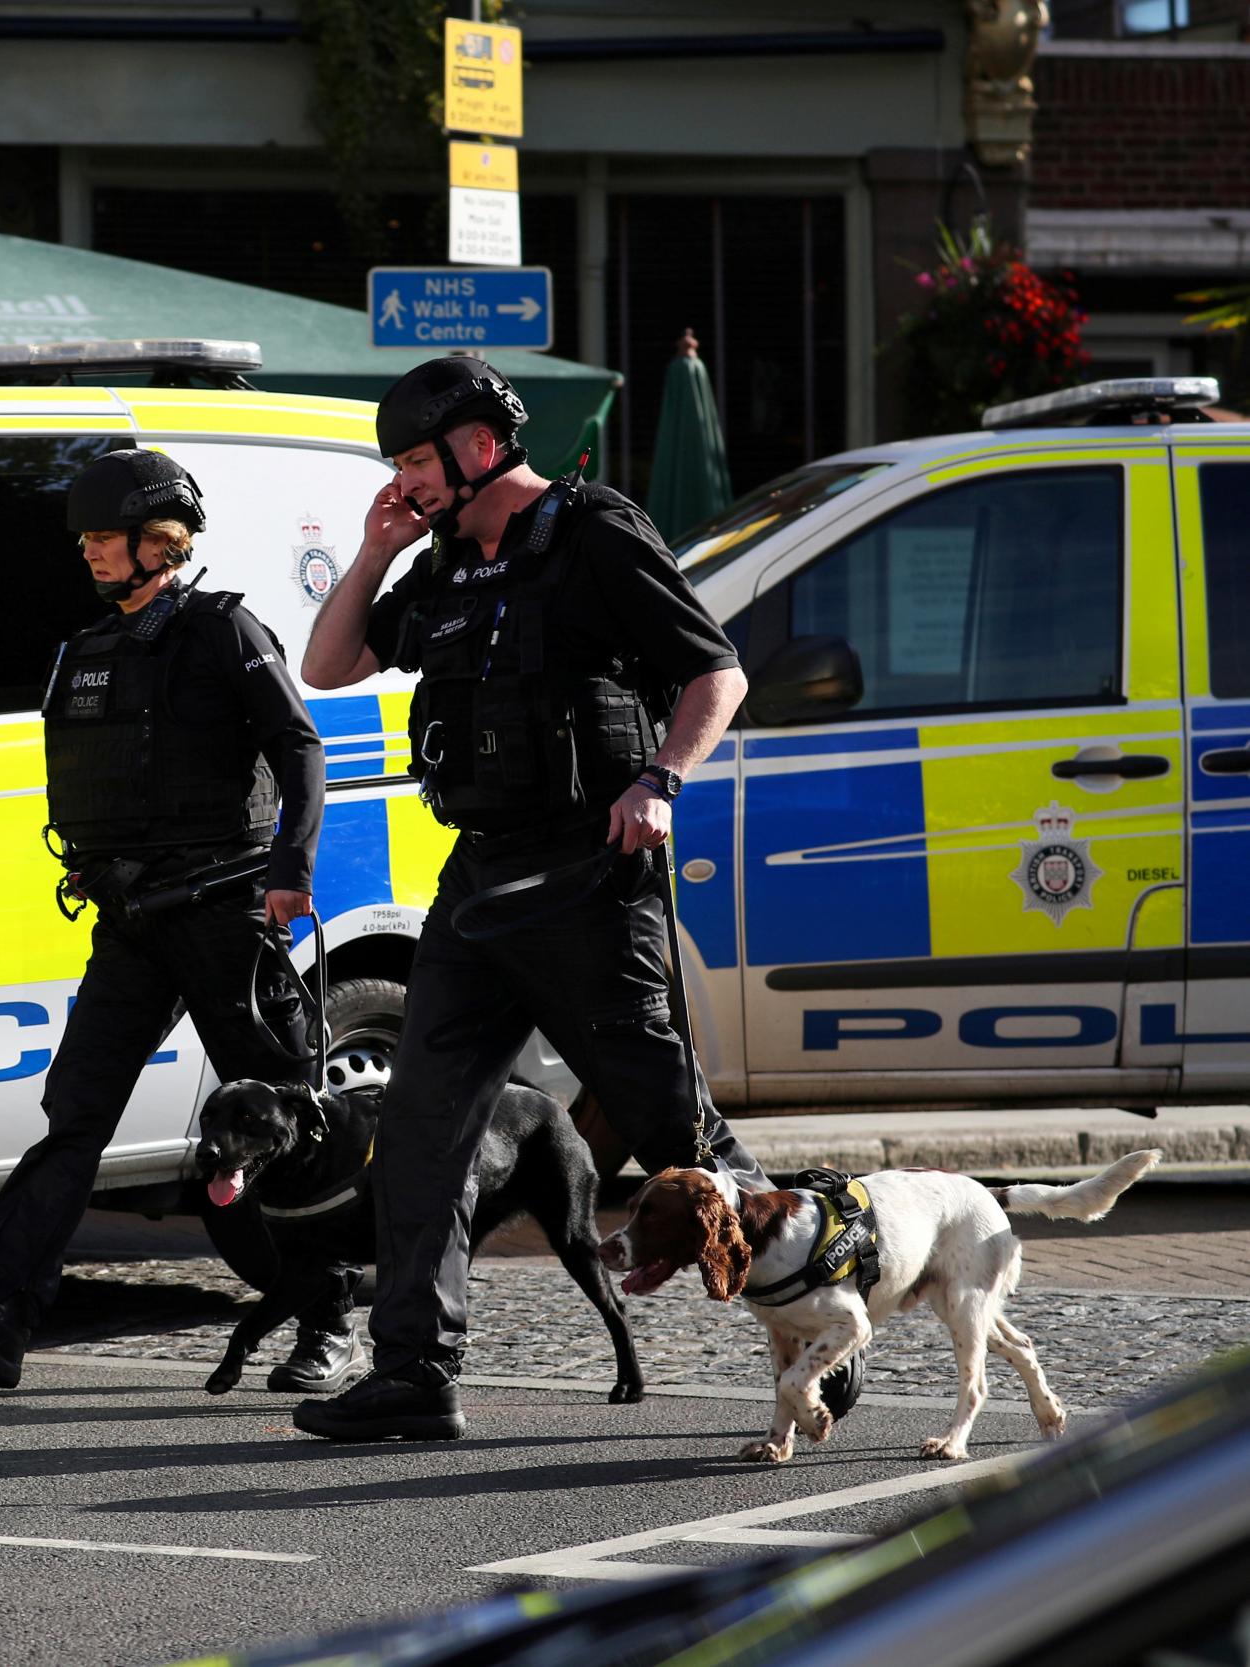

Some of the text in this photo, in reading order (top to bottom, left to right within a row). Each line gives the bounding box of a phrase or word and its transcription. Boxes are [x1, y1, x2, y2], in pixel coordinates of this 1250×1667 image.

[425, 278, 476, 296] NHS
[412, 299, 489, 319] Walk In
[415, 322, 486, 341] Centre
[472, 561, 508, 580] POLICE
[244, 653, 276, 672] POLICE
[81, 671, 110, 687] POLICE
[71, 695, 99, 708] POLICE
[1127, 868, 1180, 882] DIESEL
[827, 1223, 867, 1264] POLICE
